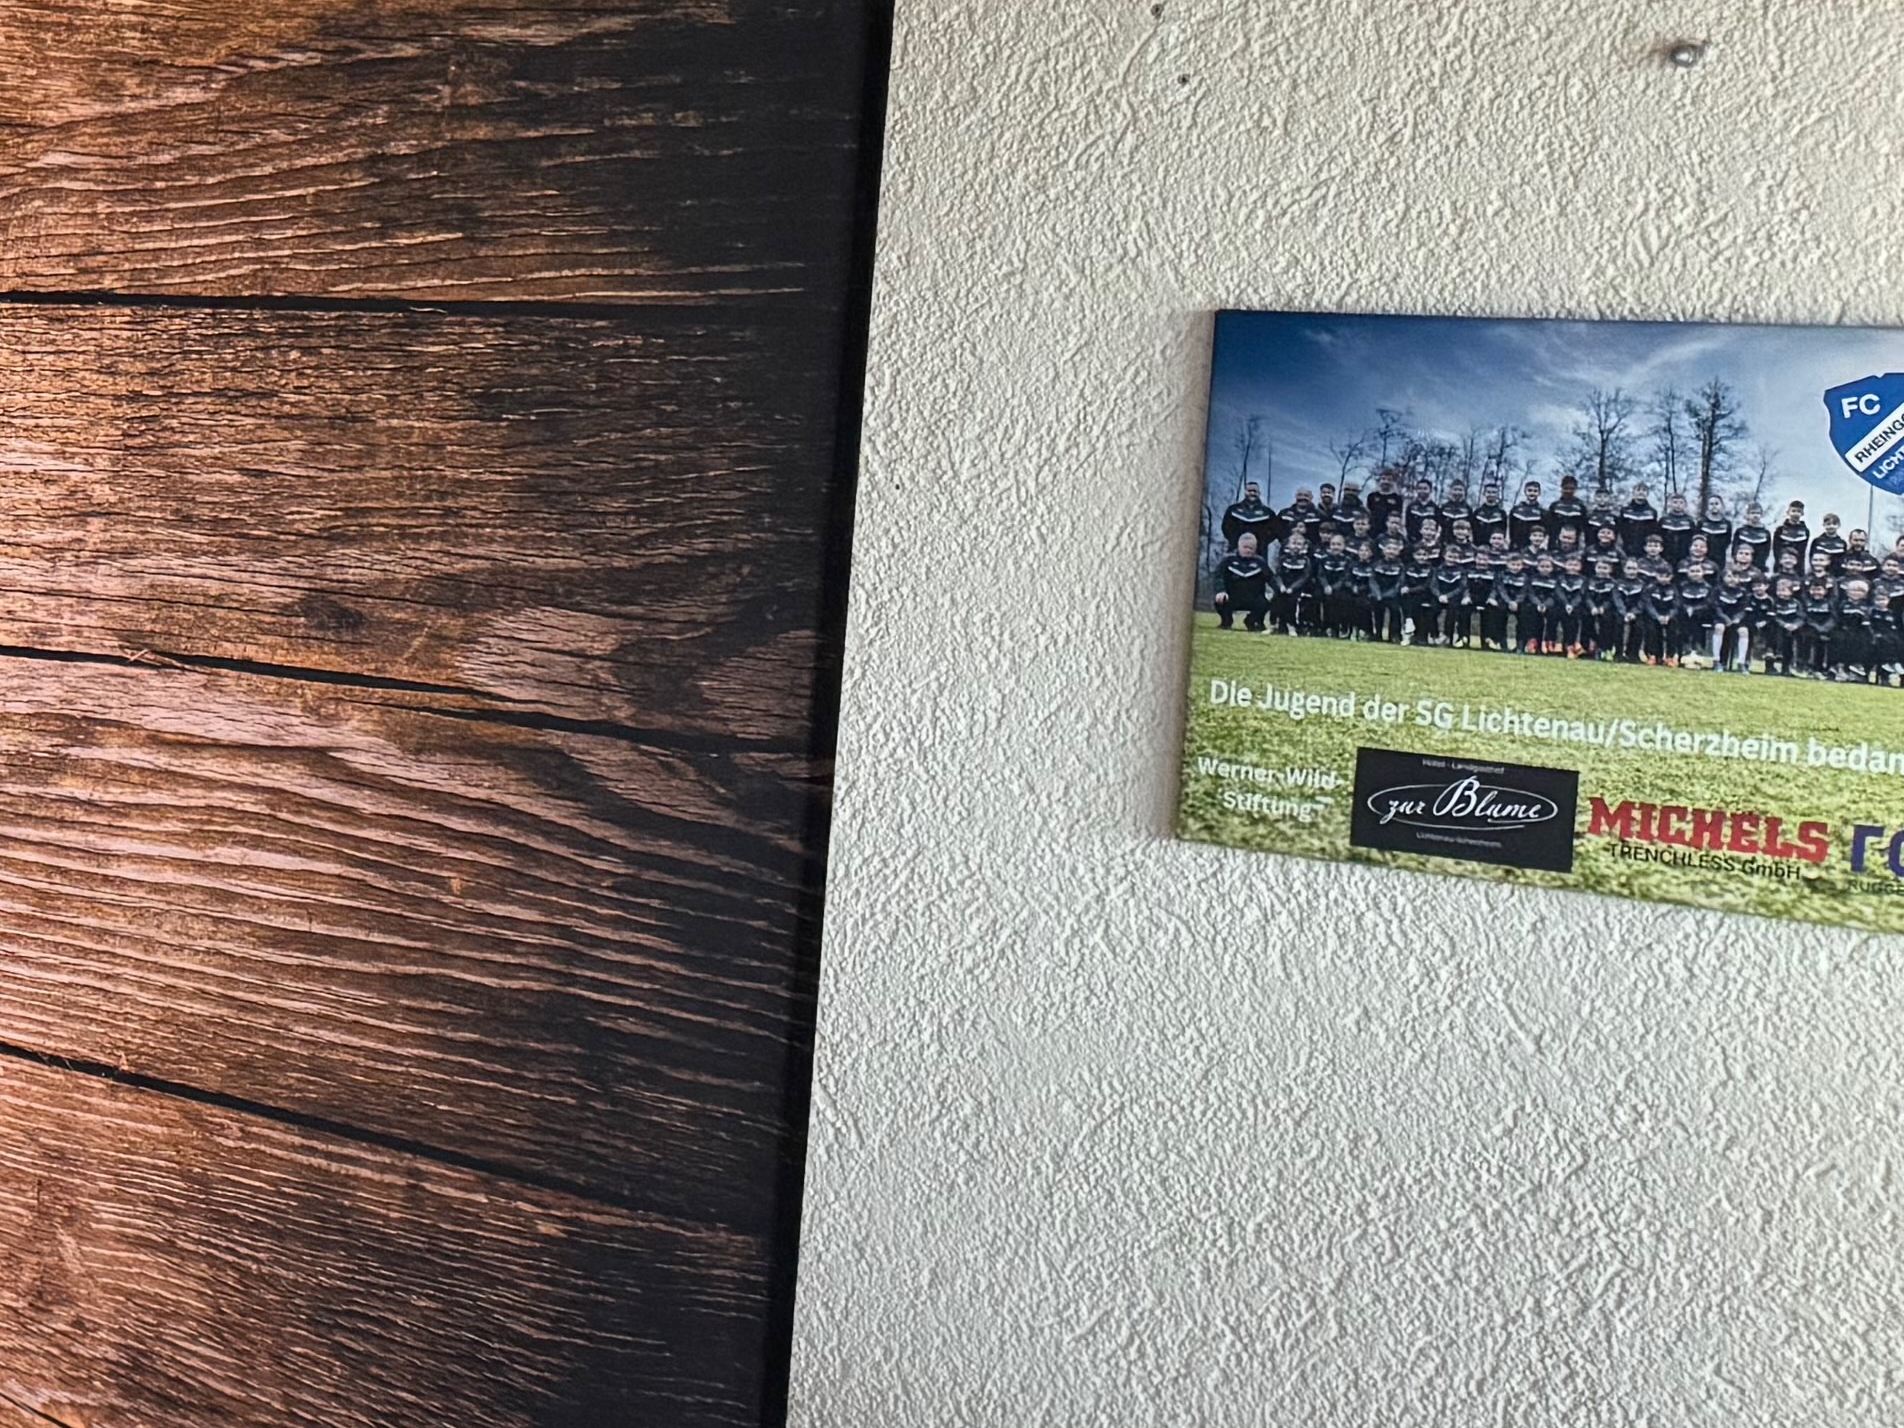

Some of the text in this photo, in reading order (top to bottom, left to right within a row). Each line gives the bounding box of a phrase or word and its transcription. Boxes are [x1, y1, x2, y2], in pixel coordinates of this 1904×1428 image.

[1841, 393, 1882, 419] FC
[1210, 679, 1253, 708] Die
[1259, 682, 1355, 721] Jugend
[1362, 693, 1410, 724] der
[1414, 698, 1454, 729] SG
[1462, 703, 1799, 765] Lichtenau/Scherzheim
[1222, 790, 1314, 823] Stiftung
[1379, 774, 1542, 825] zur Blume
[1587, 796, 1830, 864] MICHELS
[1609, 841, 1802, 881] TRENCHLESS GmbH
